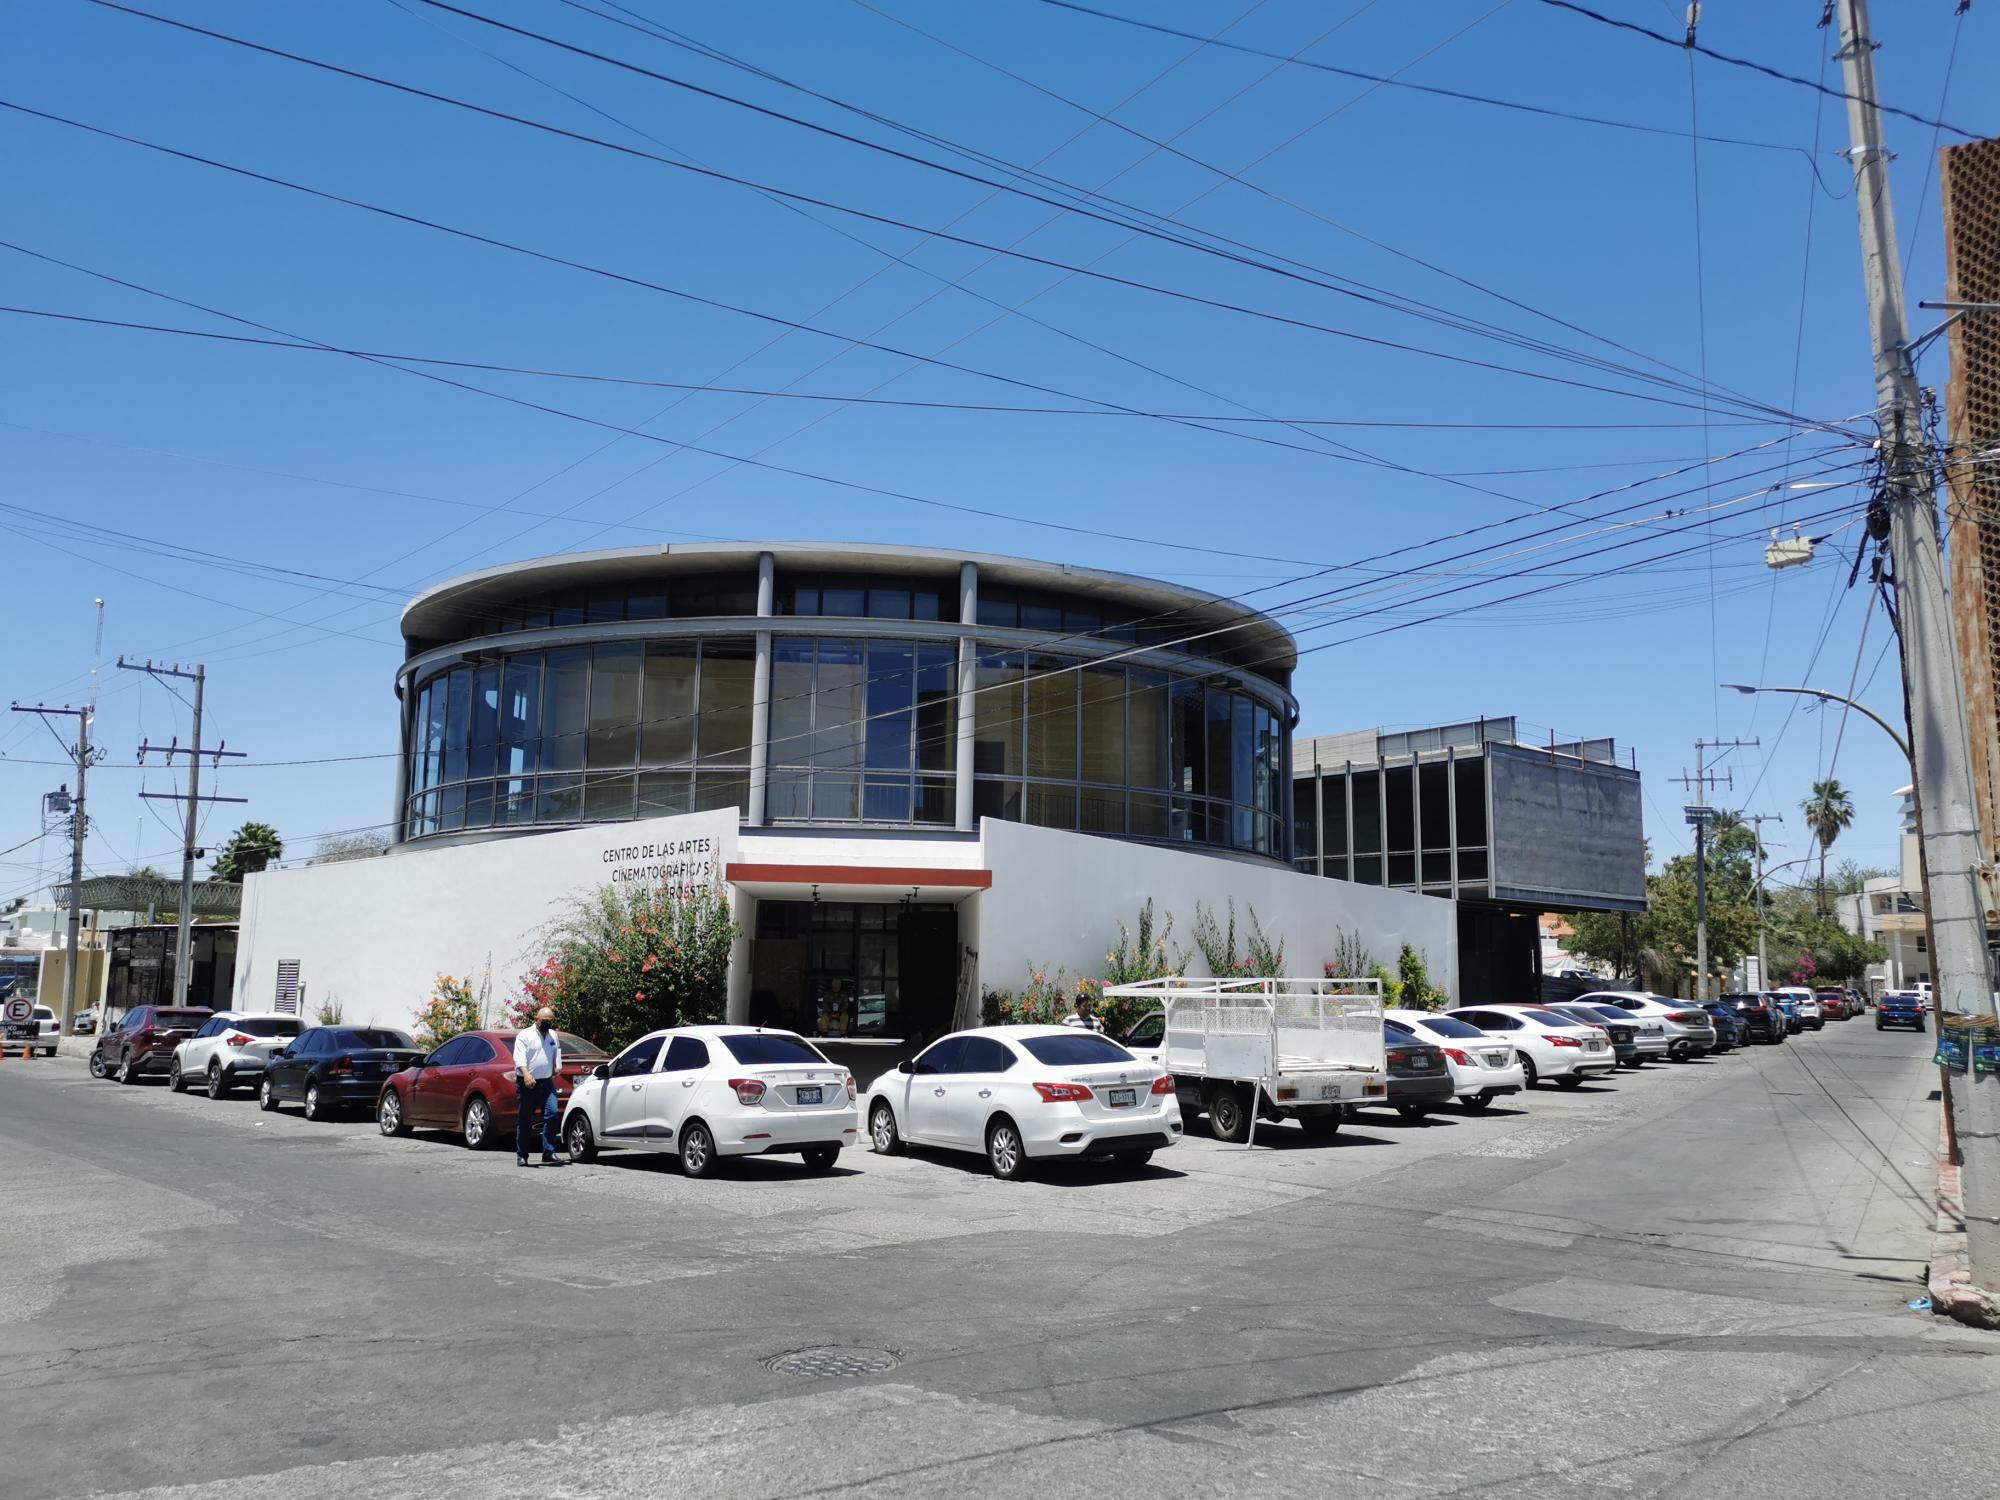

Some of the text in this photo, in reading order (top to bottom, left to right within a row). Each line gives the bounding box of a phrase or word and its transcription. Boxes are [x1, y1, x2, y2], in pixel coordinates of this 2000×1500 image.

[603, 838, 710, 863] CENTRO DE LAS ARTES
[12, 1003, 25, 1016] E
